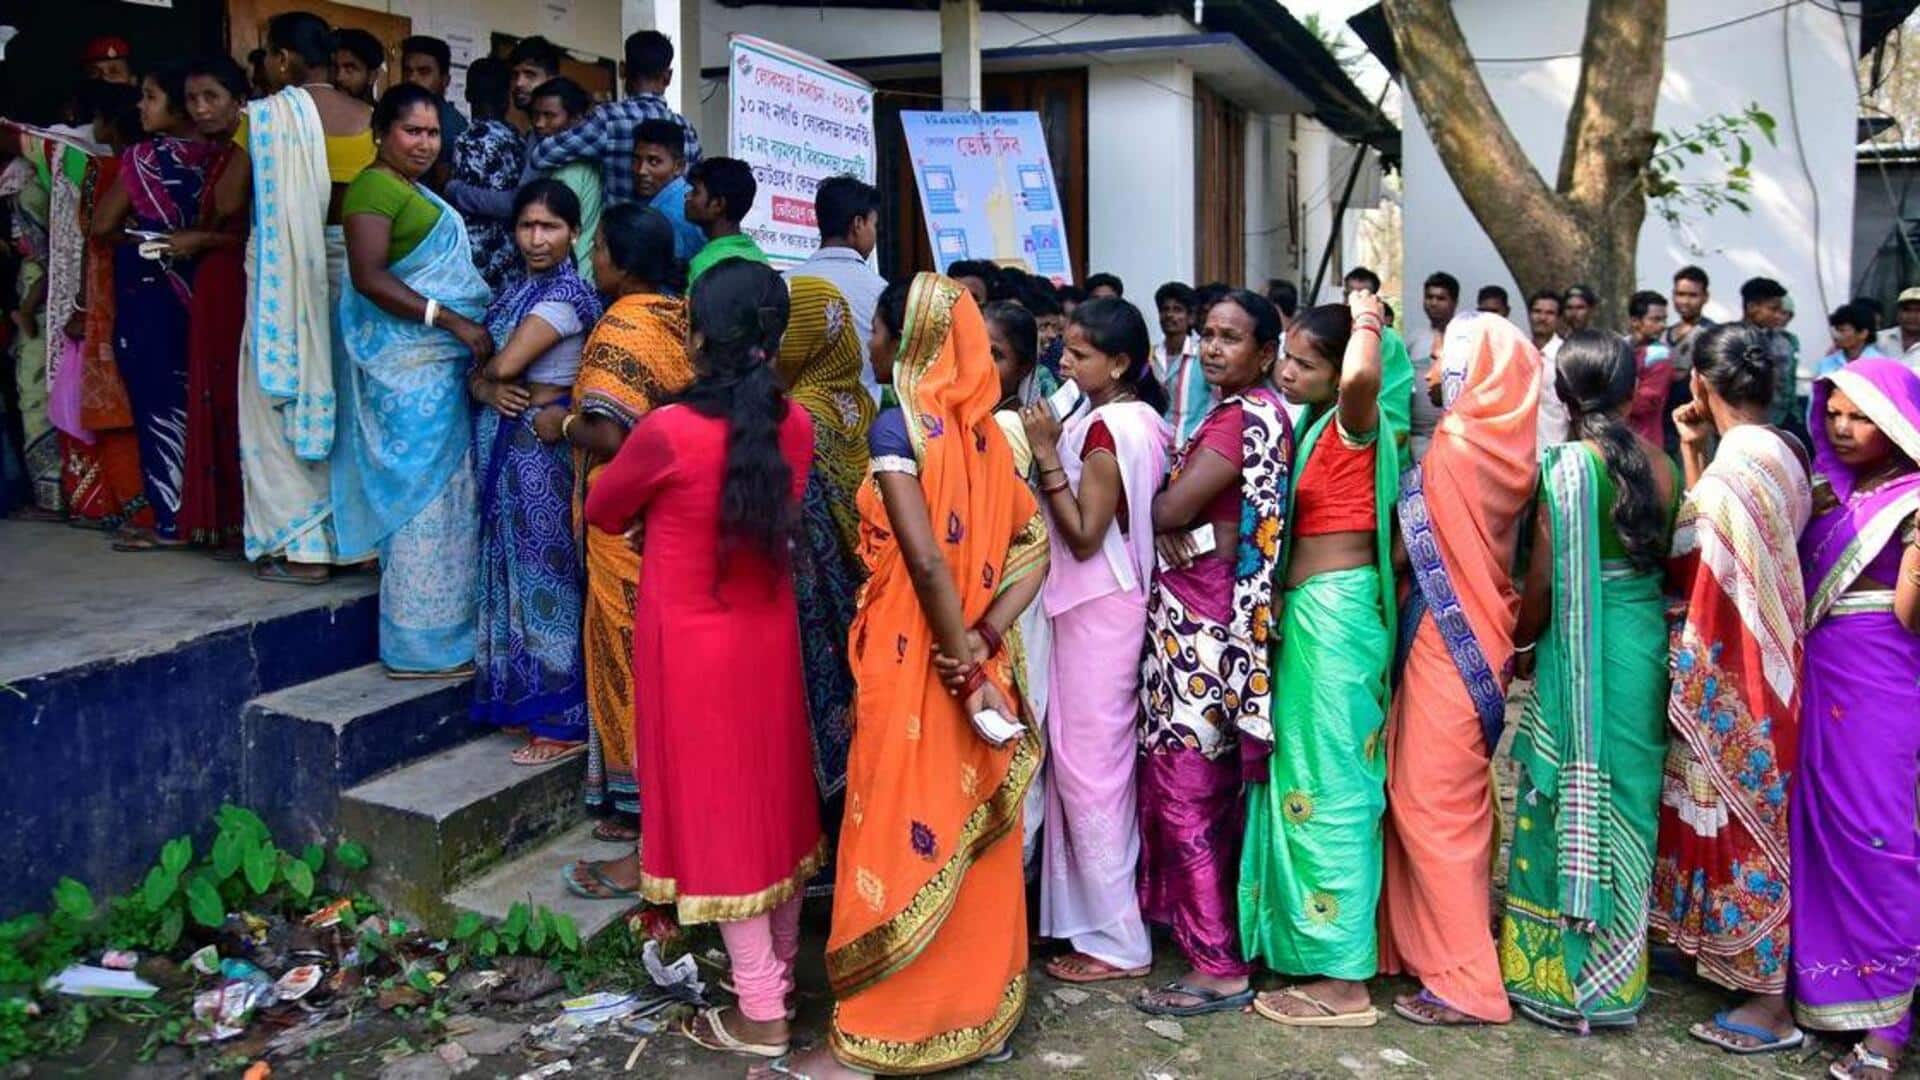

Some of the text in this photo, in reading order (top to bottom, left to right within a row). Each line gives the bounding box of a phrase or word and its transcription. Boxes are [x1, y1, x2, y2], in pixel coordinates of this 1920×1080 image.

[740, 96, 755, 113] ১০
[758, 100, 771, 120] নং
[803, 114, 842, 138] লোকসভা
[740, 132, 754, 153] ৮৭
[757, 136, 769, 156] নং
[957, 131, 992, 157] ভোট
